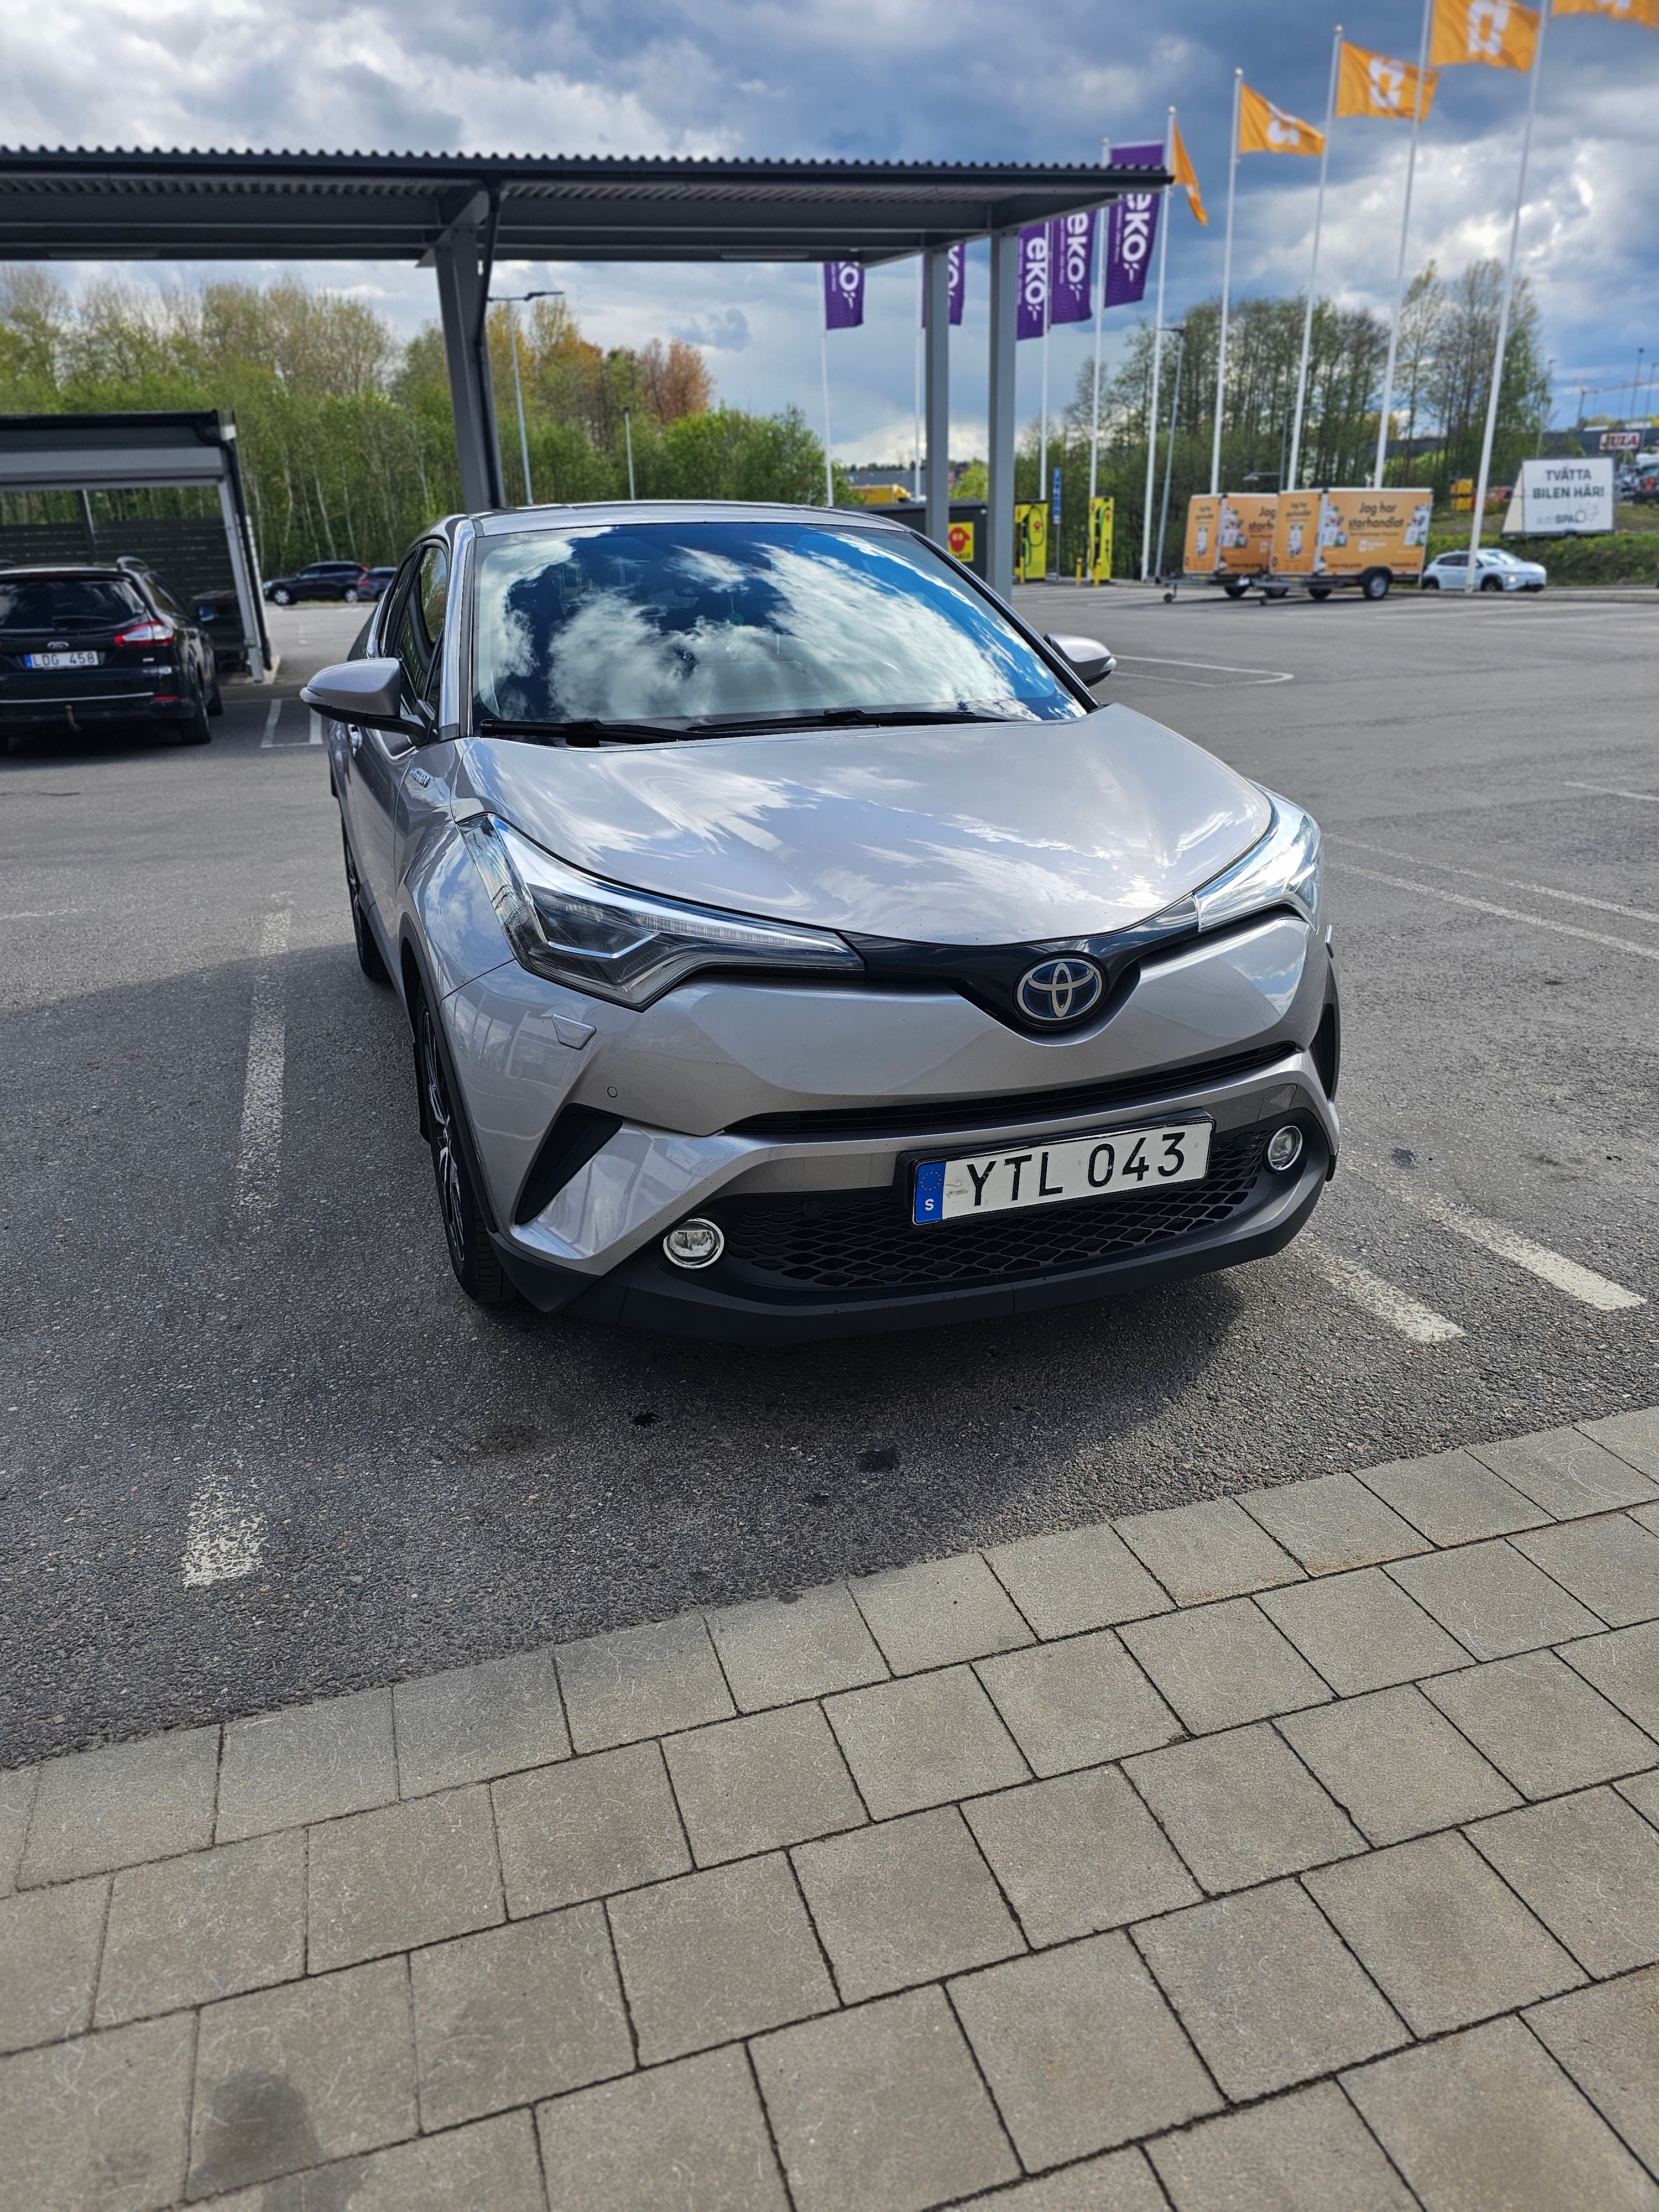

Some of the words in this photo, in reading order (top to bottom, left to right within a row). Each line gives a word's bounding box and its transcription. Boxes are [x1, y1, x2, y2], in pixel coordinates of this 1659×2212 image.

[1601, 435, 1639, 448] JULA
[1546, 466, 1592, 481] TVÄTTA
[1532, 486, 1571, 499] BILEN
[1574, 484, 1605, 498] HÄR!
[1359, 501, 1377, 517] Jag
[1379, 500, 1397, 513] har
[1348, 517, 1404, 529] storhandlat
[33, 654, 59, 667] LDG
[70, 653, 95, 664] 458
[966, 1151, 1063, 1206] YTL
[1087, 1131, 1186, 1188] 043
[925, 1198, 934, 1211] S
